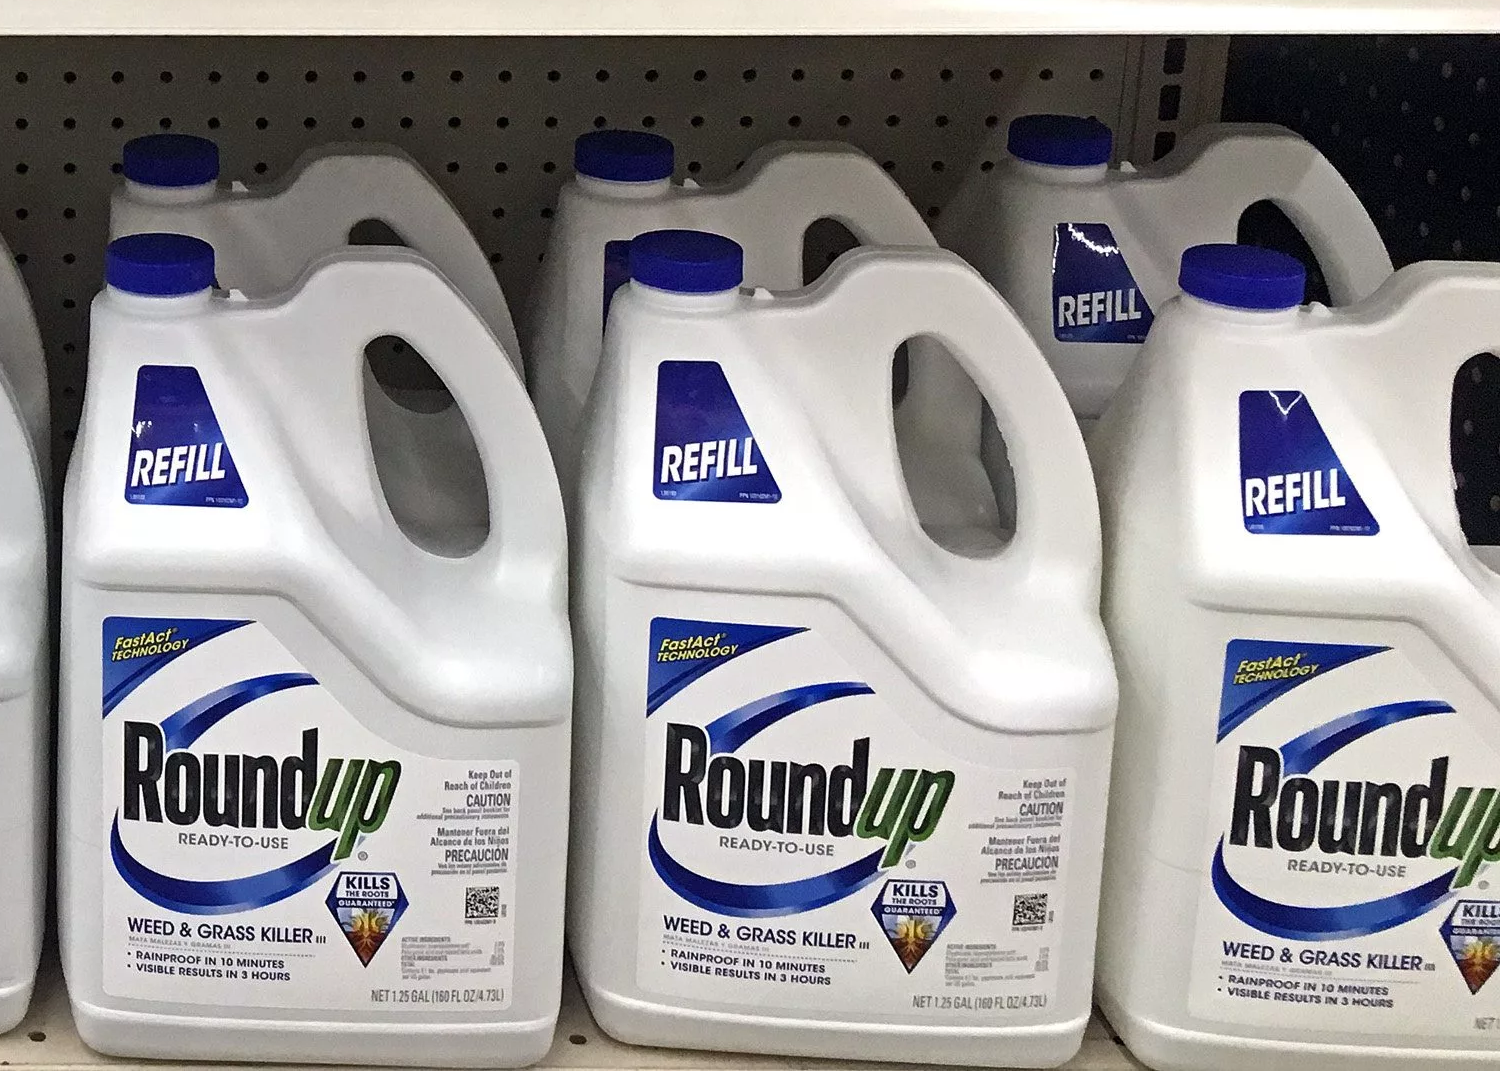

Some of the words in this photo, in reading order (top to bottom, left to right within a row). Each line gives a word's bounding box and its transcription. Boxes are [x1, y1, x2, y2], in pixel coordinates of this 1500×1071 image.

[1059, 287, 1142, 327] REFILL
[131, 442, 226, 487] REFILL
[662, 438, 758, 482] REFILL
[1244, 470, 1347, 517] REFILL
[114, 630, 173, 649] FastAct
[660, 634, 721, 651] FastAct
[112, 640, 189, 661] TECHNOLOGY
[658, 645, 738, 662] TECHNOLOGY
[1237, 656, 1301, 673] FastAct
[1234, 665, 1320, 684] TECHNOLOGY
[123, 721, 402, 862] Roundup
[466, 793, 511, 808] CAUTION
[662, 722, 957, 870] Roundup
[1019, 802, 1063, 819] CAUTION
[179, 833, 288, 849] READY-TO-USE
[720, 836, 834, 856] READY-TO-USE
[1288, 859, 1406, 877] READY-TO-USE
[345, 875, 391, 890] KILLS
[892, 883, 939, 899] KILLS
[128, 917, 174, 935] WEED
[180, 922, 191, 937] &
[198, 924, 255, 941] GRASS
[261, 927, 313, 943] KILLER
[664, 915, 712, 936] WEED
[718, 924, 730, 939] &
[737, 926, 796, 945] GRASS
[803, 931, 856, 948] KILLER
[1223, 941, 1274, 961] WEED
[1280, 948, 1292, 962] &
[1300, 950, 1361, 968] GRASS
[1367, 954, 1422, 970] KILLER
